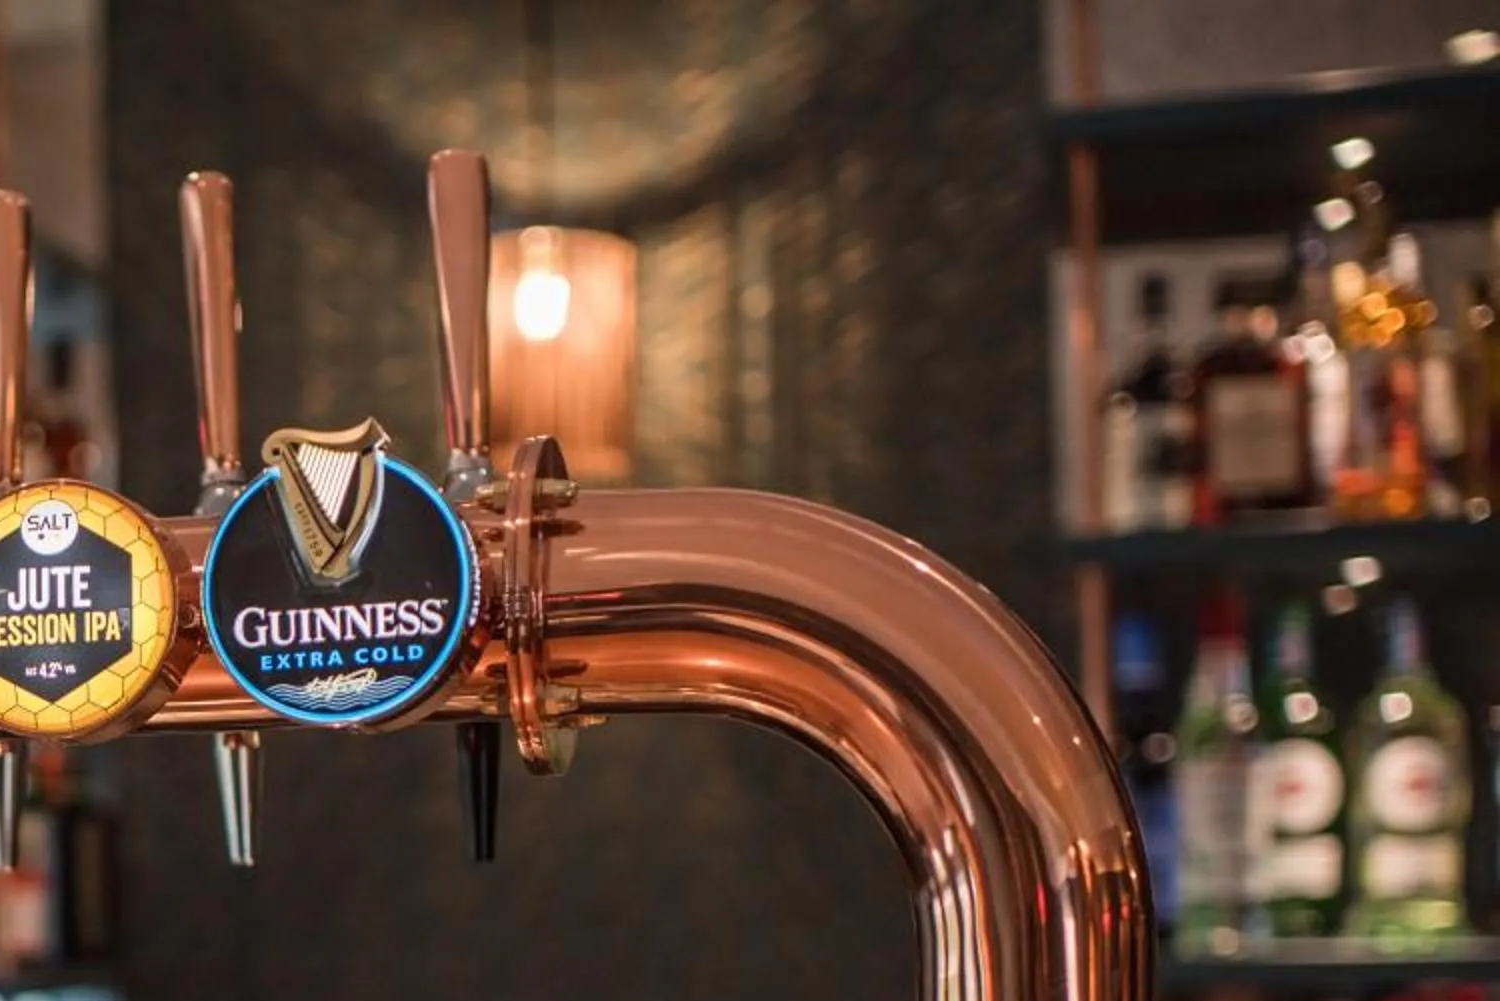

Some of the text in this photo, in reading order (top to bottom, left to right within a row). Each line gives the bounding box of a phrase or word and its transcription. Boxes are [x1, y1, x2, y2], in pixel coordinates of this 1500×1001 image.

[27, 512, 73, 531] SALT
[6, 564, 92, 612] JUTE
[83, 609, 122, 643] IPA
[233, 599, 446, 648] GUINNESS
[259, 644, 424, 672] EXTRA COLD
